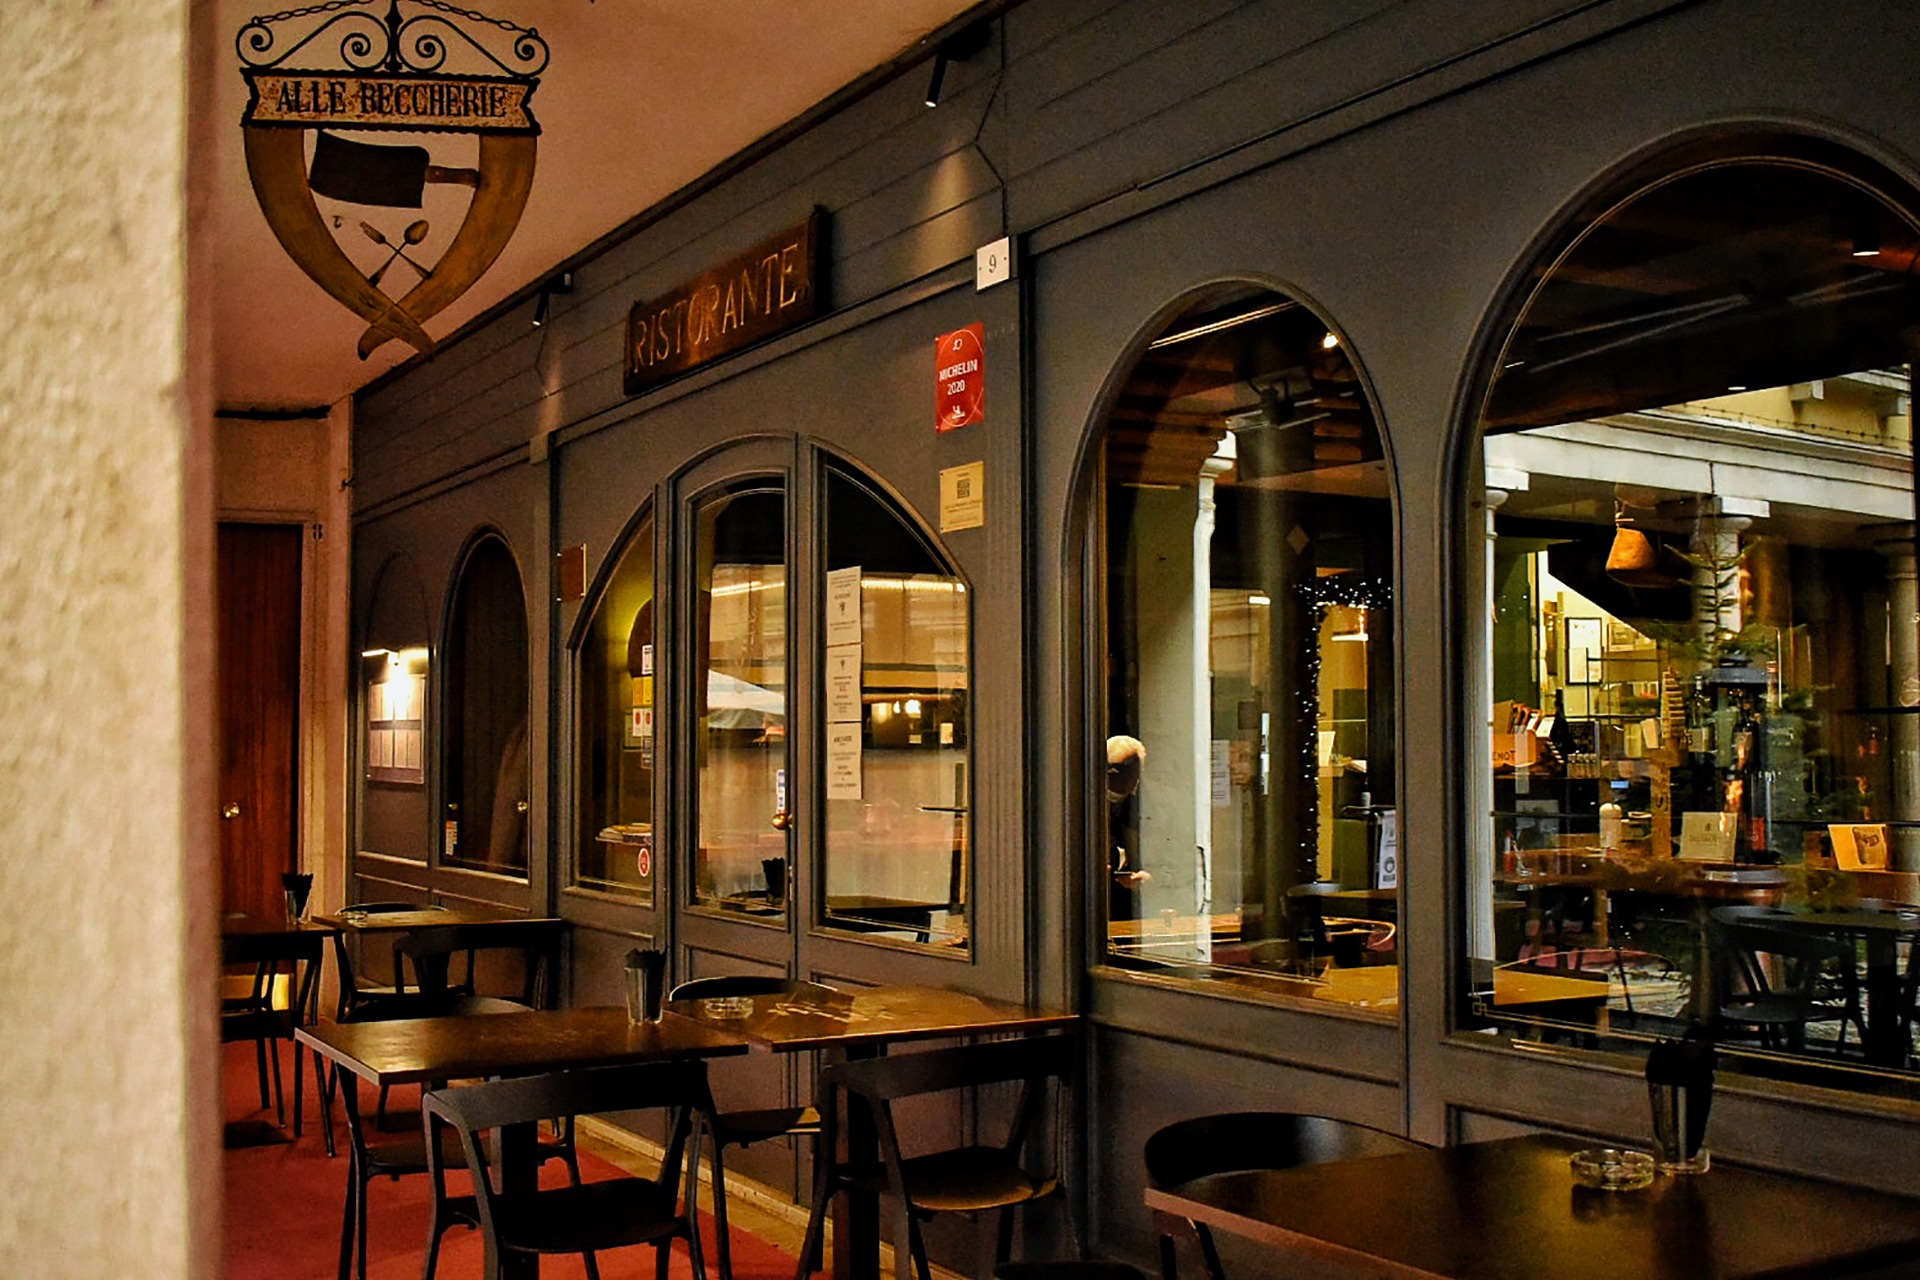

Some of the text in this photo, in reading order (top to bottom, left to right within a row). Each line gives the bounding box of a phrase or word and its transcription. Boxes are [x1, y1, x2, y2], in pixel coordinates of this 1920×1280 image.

[276, 80, 508, 118] ALLE BECCHERIE
[988, 254, 997, 274] 9
[633, 243, 798, 373] RISTORANTE
[939, 358, 978, 382] MICHELIN
[947, 379, 966, 396] 2020
